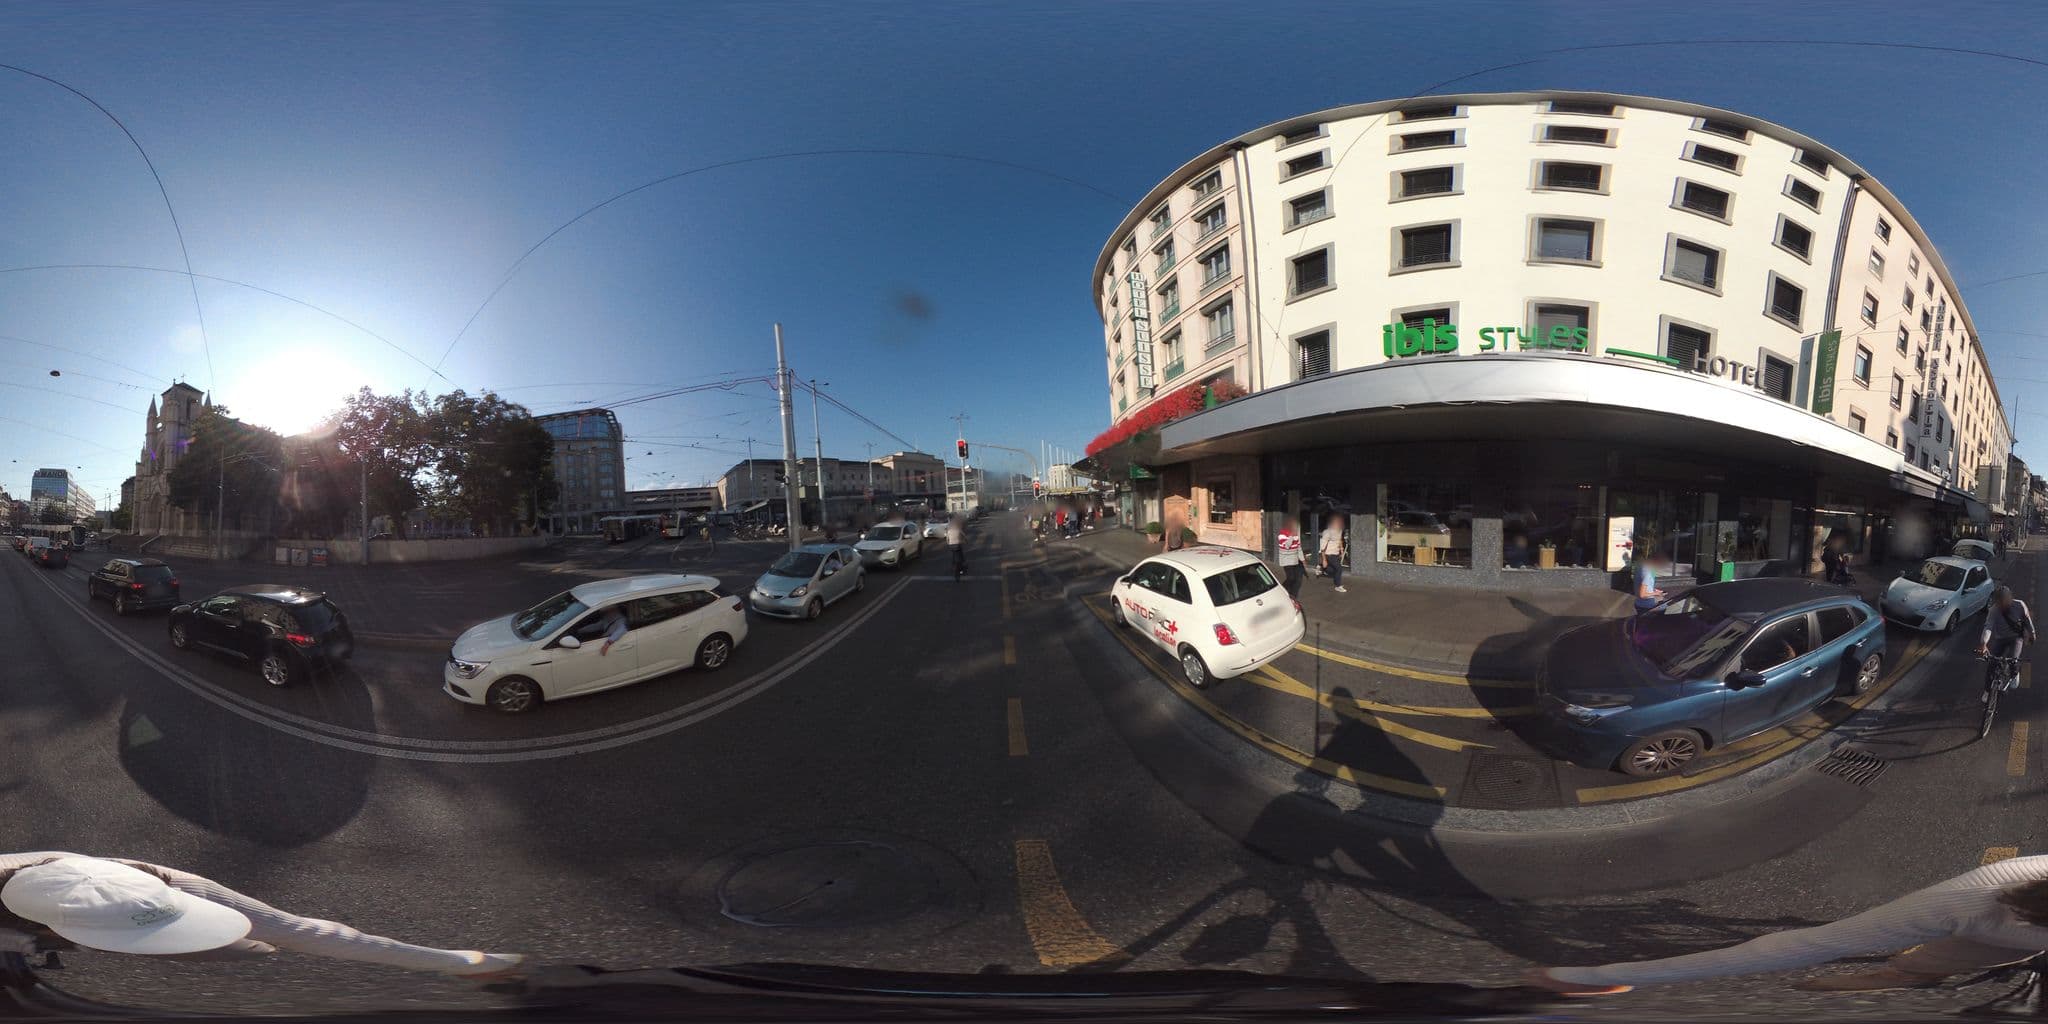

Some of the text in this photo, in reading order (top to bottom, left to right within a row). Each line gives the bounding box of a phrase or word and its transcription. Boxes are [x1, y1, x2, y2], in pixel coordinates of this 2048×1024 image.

[1132, 272, 1153, 387] HOTEL SUISSE
[1383, 318, 1459, 358] ibis
[1694, 349, 1768, 391] HOTEL
[1818, 376, 1832, 403] ibis
